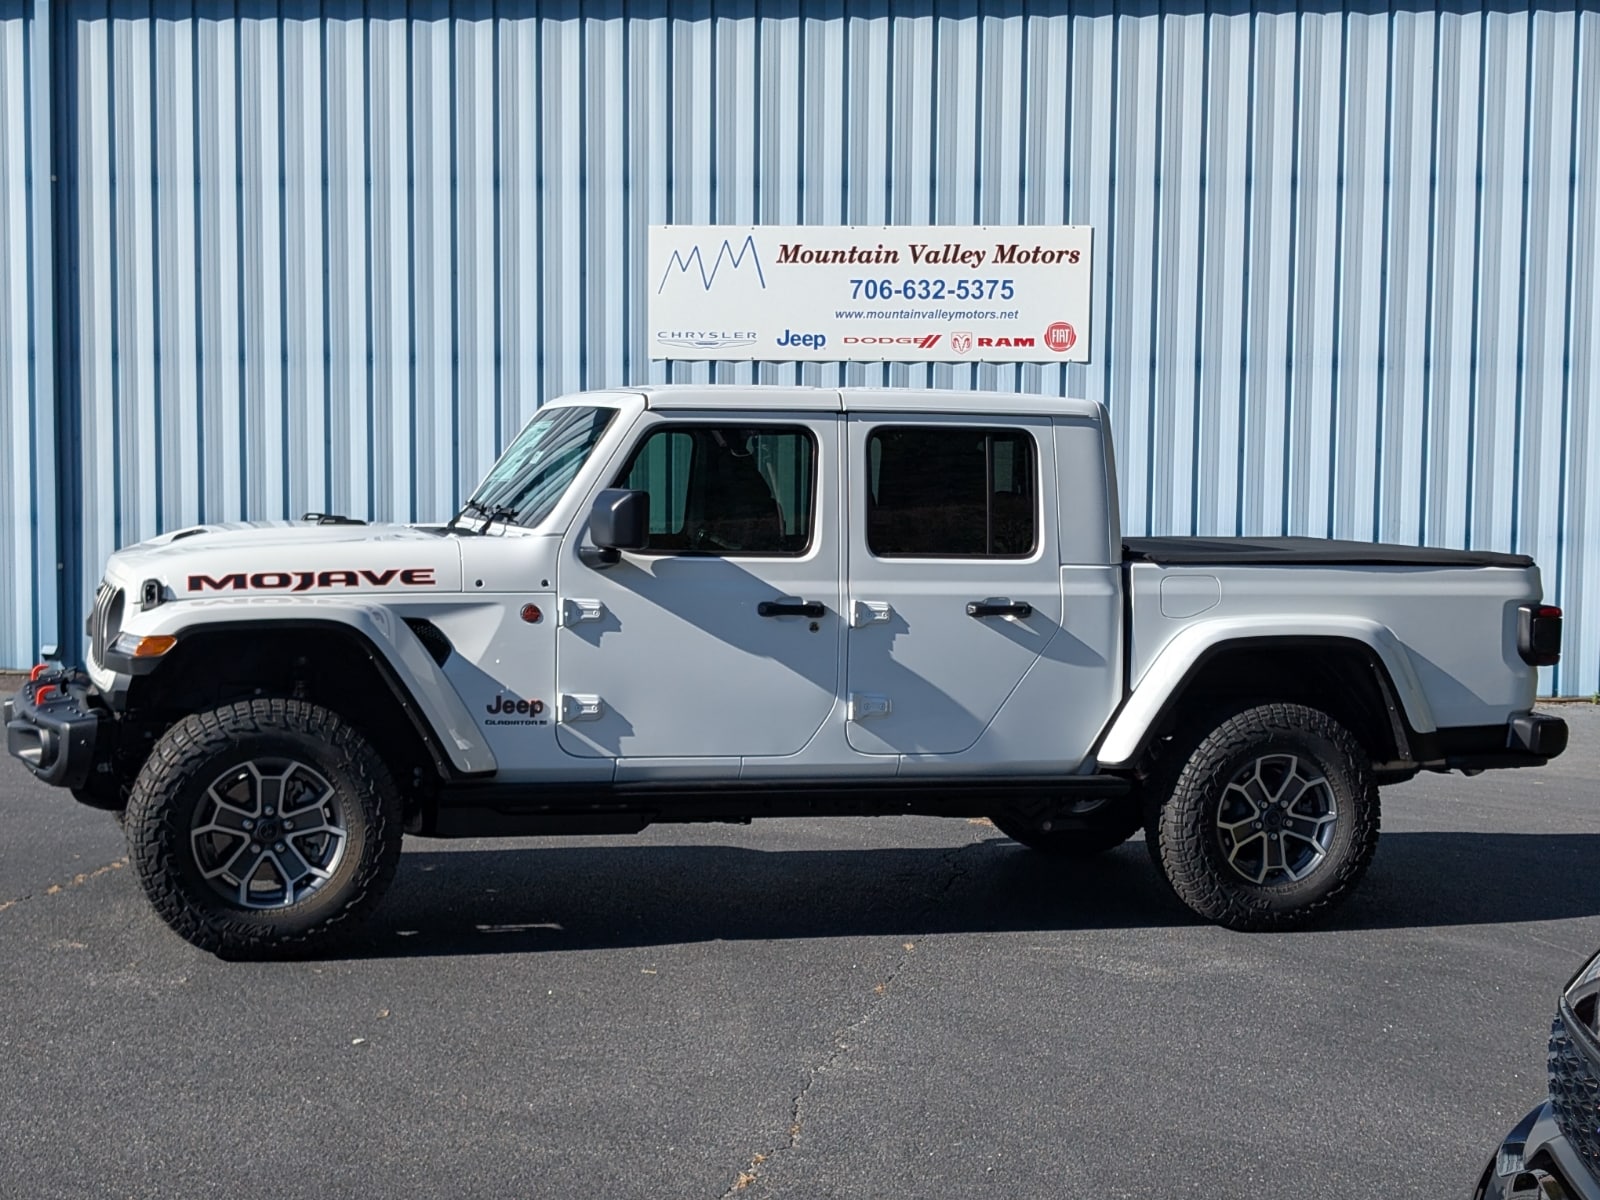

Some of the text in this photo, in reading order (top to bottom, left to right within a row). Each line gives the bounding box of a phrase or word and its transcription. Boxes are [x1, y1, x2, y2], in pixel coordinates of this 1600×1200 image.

[776, 244, 1081, 269] Mountain Valley Motors
[849, 279, 1015, 300] 706-632-5375
[834, 308, 1019, 321] www.mountainvalleymotors.net
[657, 331, 757, 339] CHRYSLER
[776, 329, 826, 350] Jeep
[977, 337, 1035, 347] RAM
[1051, 328, 1070, 344] FIAT
[187, 568, 436, 592] MOJAVE
[486, 695, 544, 717] Jeep
